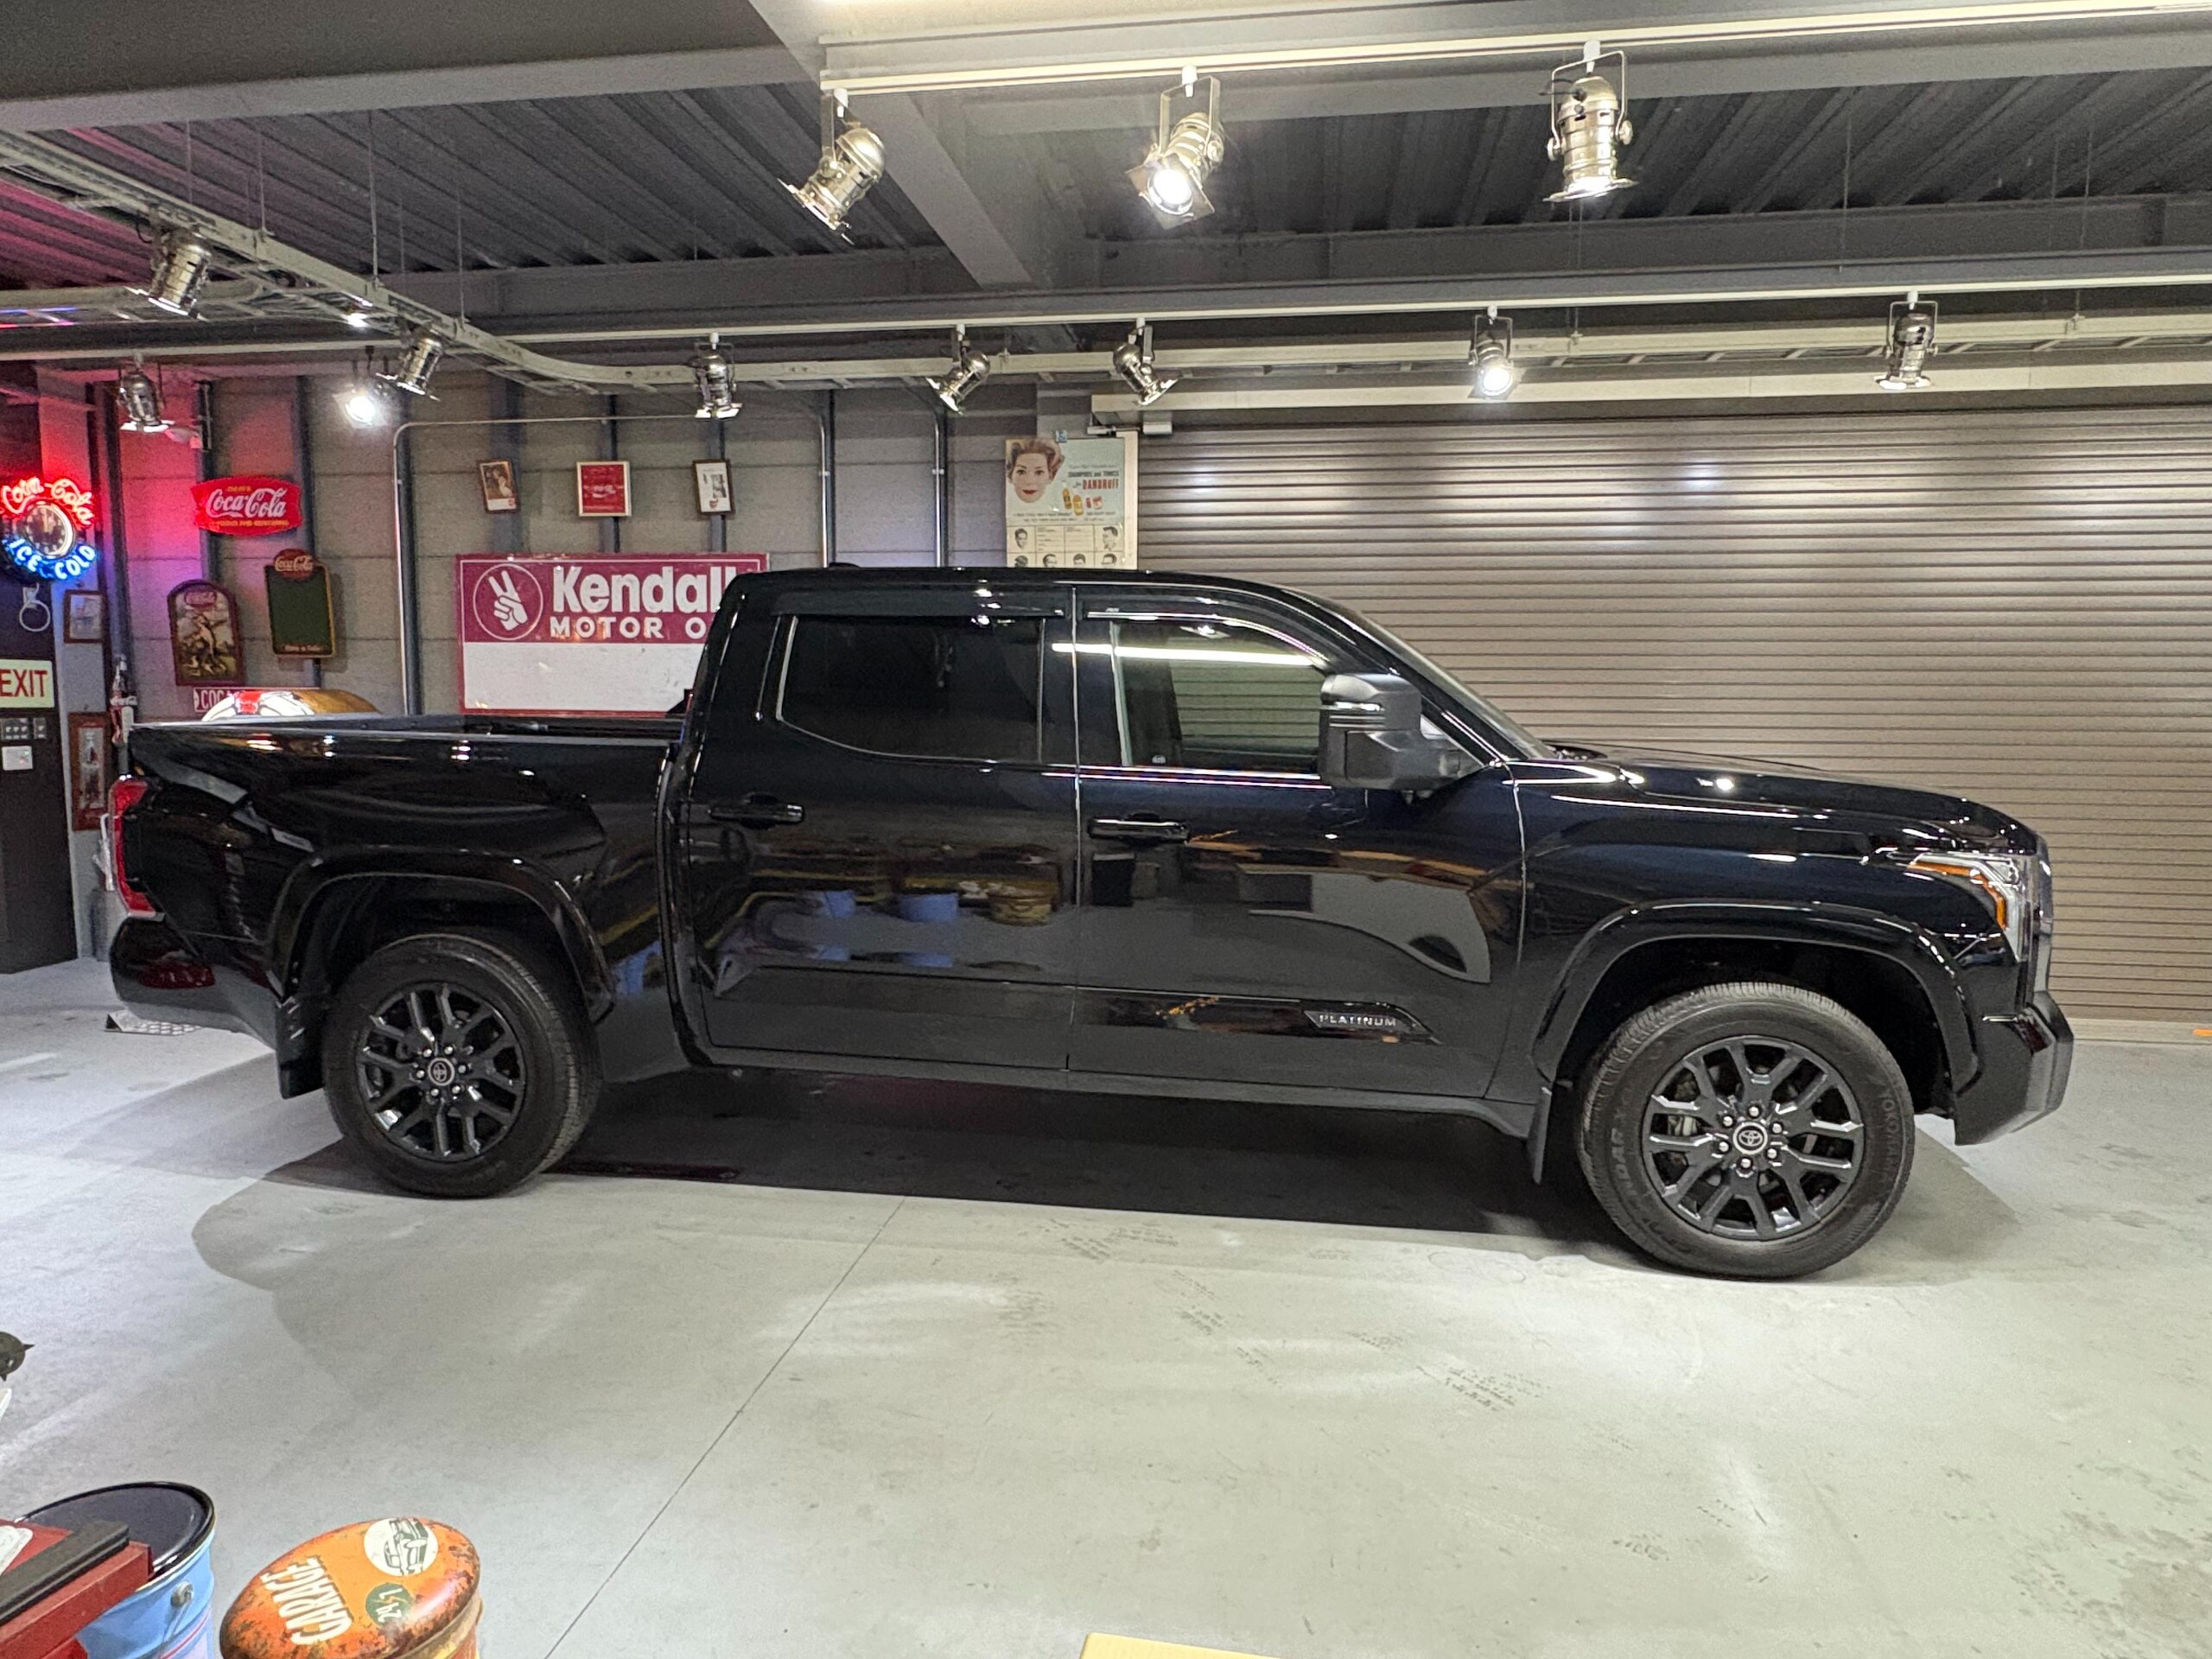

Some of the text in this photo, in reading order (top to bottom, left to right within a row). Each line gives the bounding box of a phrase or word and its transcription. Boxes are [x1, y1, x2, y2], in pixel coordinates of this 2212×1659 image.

[206, 487, 288, 518] Coca-Cola
[9, 538, 96, 580] ICE COLD
[550, 616, 707, 639] MOTOR O
[0, 669, 48, 697] EXIT
[1319, 1014, 1396, 1027] PLATINUM
[260, 1555, 353, 1645] GARAGE
